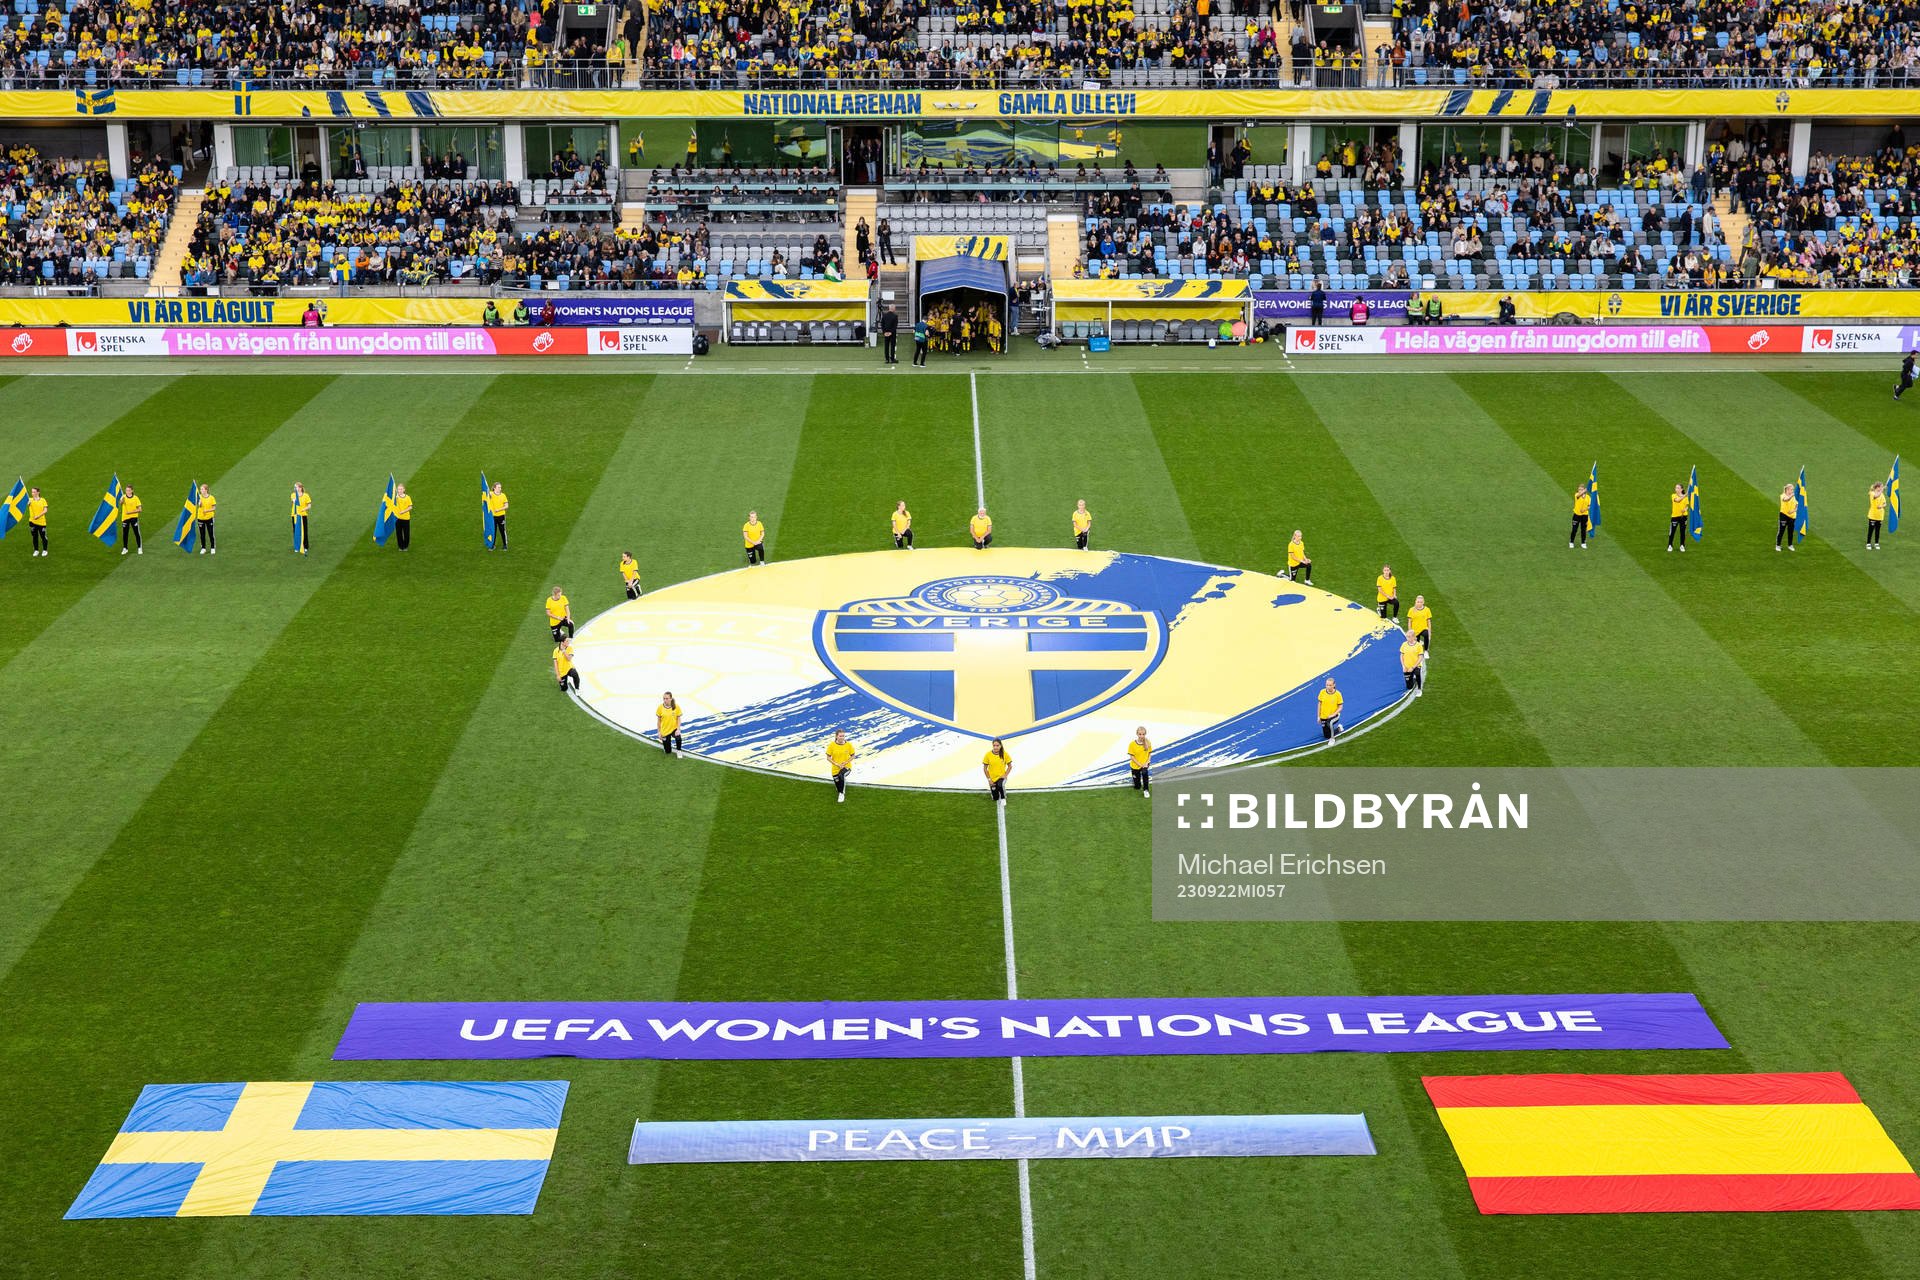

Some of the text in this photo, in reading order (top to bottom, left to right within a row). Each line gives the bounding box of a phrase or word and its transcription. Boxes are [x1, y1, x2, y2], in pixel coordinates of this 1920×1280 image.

[743, 93, 922, 115] NATIONALARENAN
[998, 93, 1136, 115] GAMLA ULLEVI
[1278, 300, 1328, 309] WOMES
[1378, 299, 1410, 309] LEAG
[1659, 293, 1802, 316] VI ÄR SVERIGE
[128, 299, 275, 323] VI ÄR BLÅGULT
[603, 306, 650, 316] NATIONS
[652, 306, 693, 316] LEAGUE
[100, 335, 146, 344] SVENSKA
[623, 334, 668, 343] SVENSKA
[1319, 333, 1364, 342] SVENSKA
[1394, 329, 1700, 352] Hela vägen från ungdom till elit
[1835, 332, 1881, 341] SVENSKA
[176, 330, 485, 355] Hela vägen från ungdom till elit
[623, 343, 647, 351] SPEL
[1319, 342, 1342, 351] SPEL
[1835, 341, 1858, 350] SPEL
[101, 344, 125, 353] SPEL
[870, 615, 1109, 628] SVERIGE
[459, 1009, 1603, 1042] UEFA WOMEN'S NATIONS LEAGUE
[807, 1125, 991, 1151] PEACE
